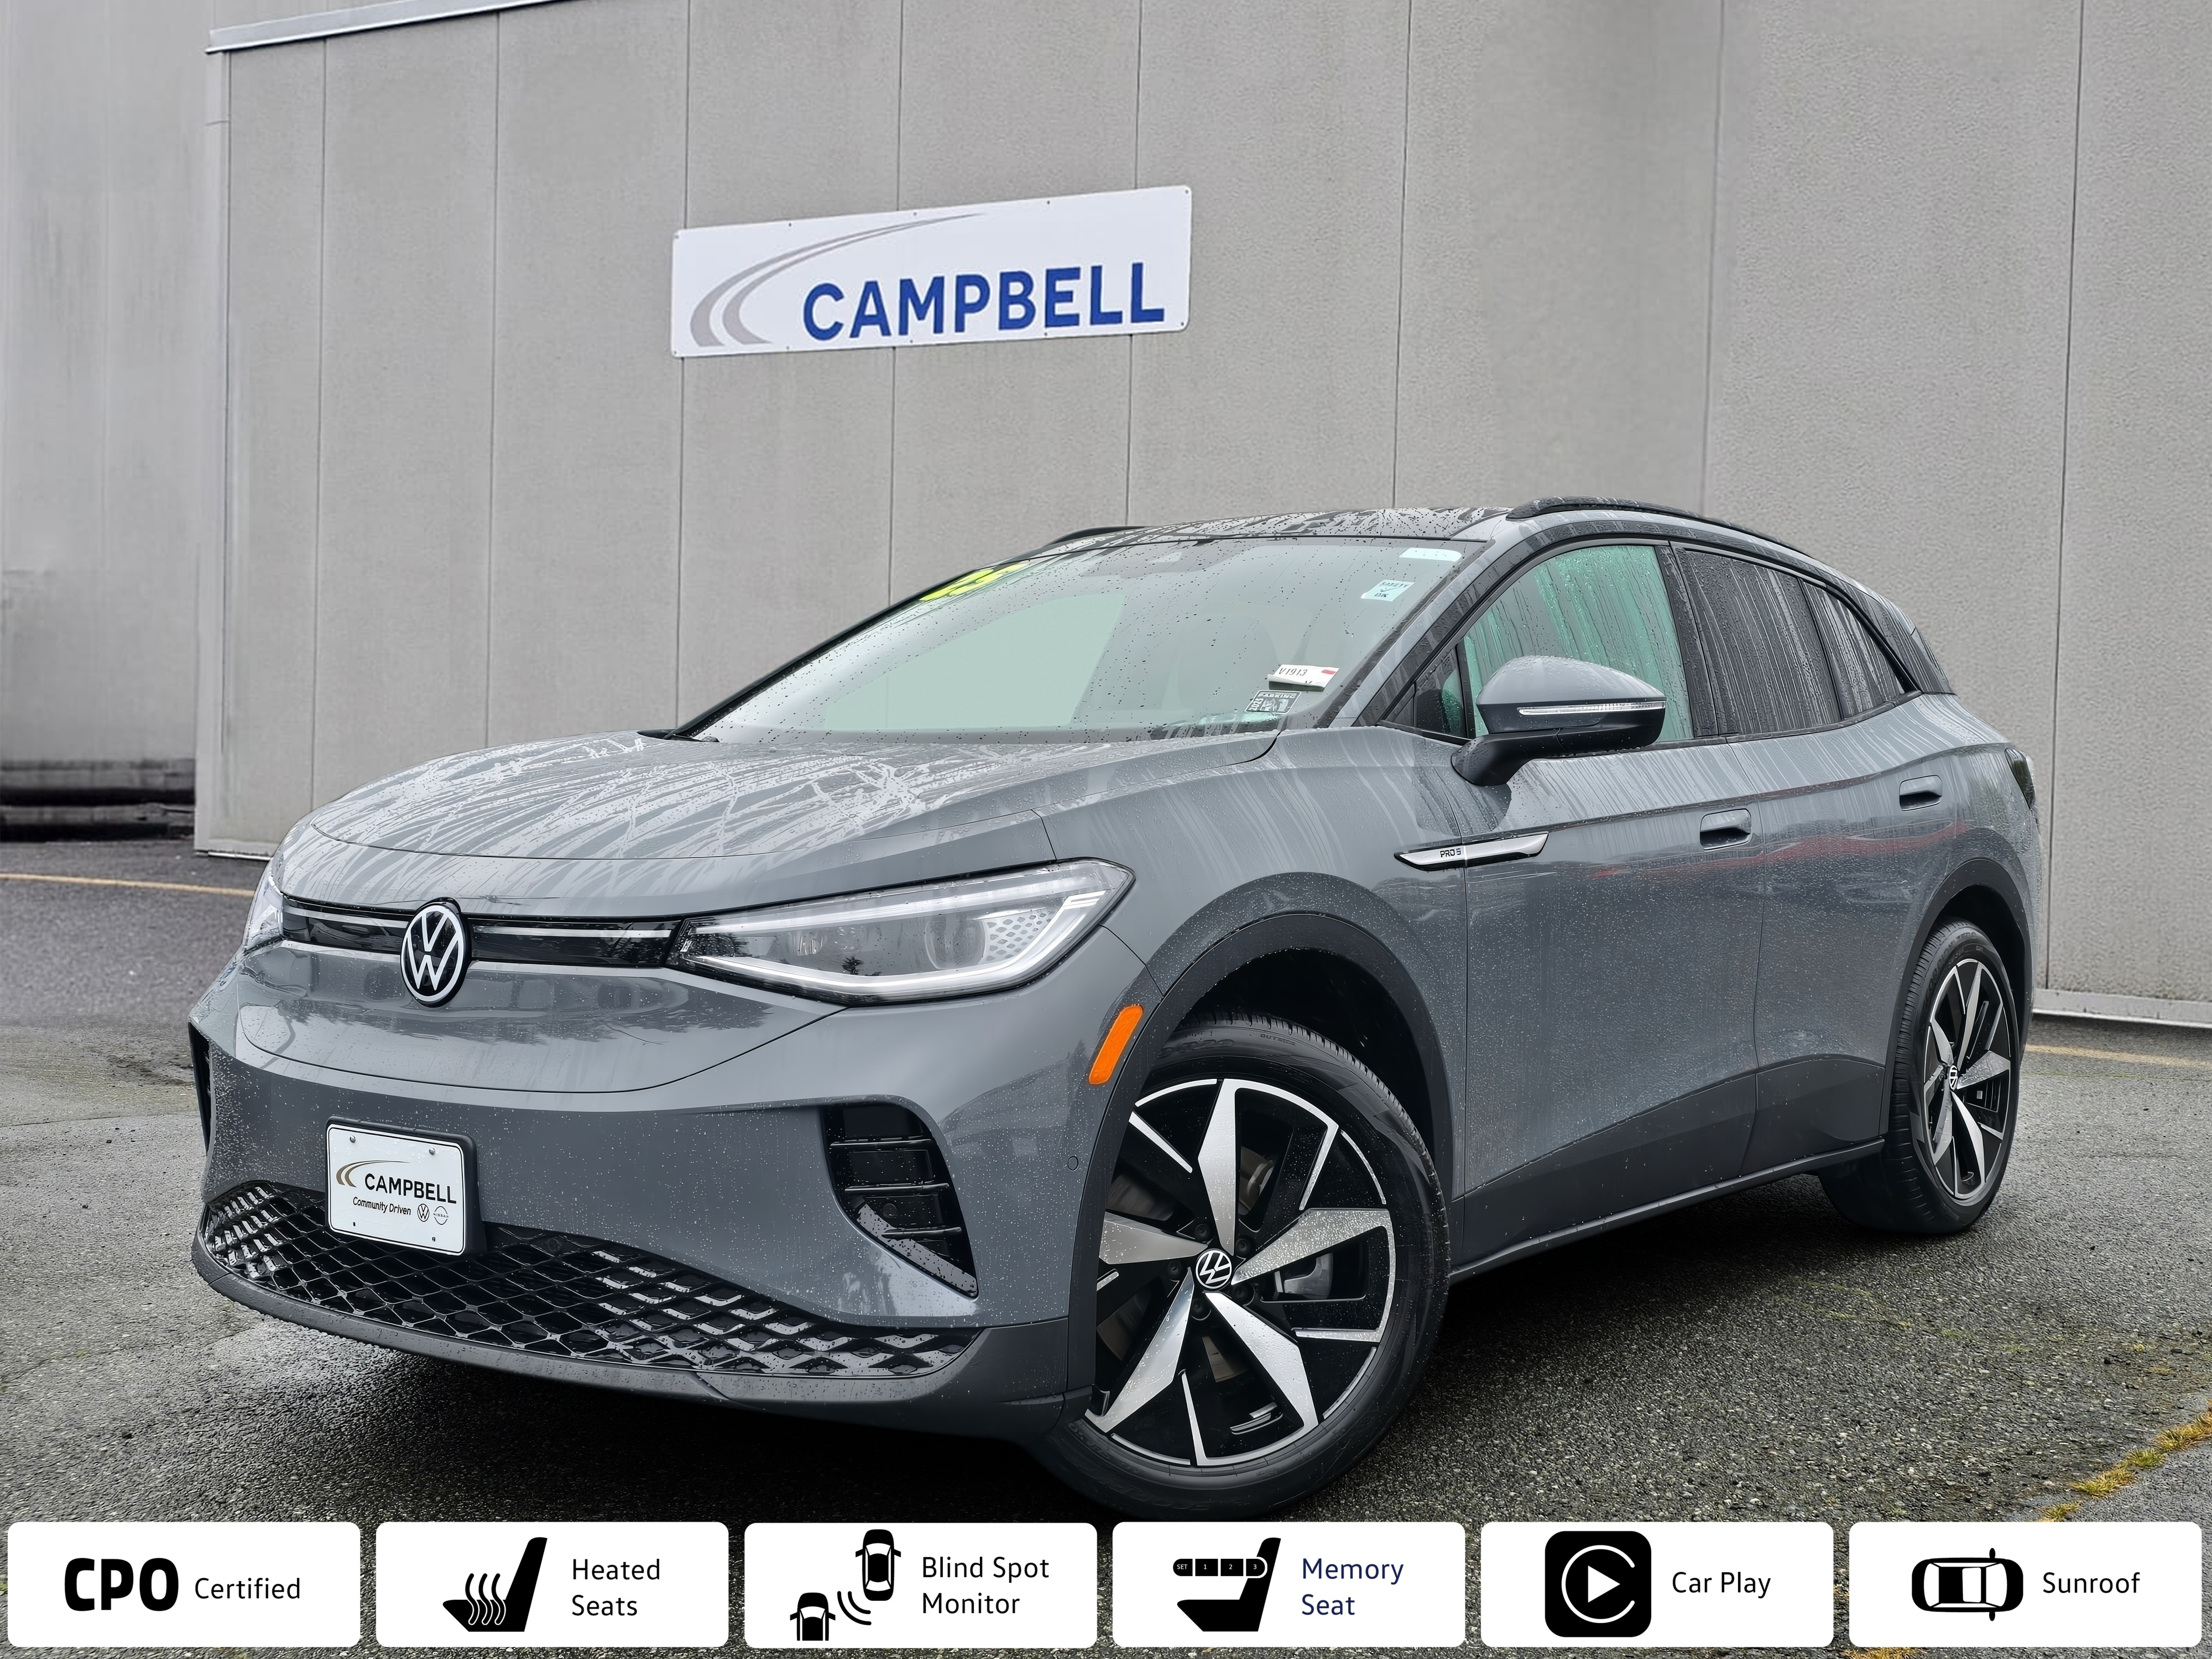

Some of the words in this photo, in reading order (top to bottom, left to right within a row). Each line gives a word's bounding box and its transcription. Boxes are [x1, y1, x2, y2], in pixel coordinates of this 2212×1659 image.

[804, 262, 1165, 341] CAMPBELL
[1439, 849, 1455, 858] PRO
[364, 1173, 457, 1204] CAMPBELL
[353, 1196, 388, 1214] Community
[389, 1203, 411, 1215] Driven
